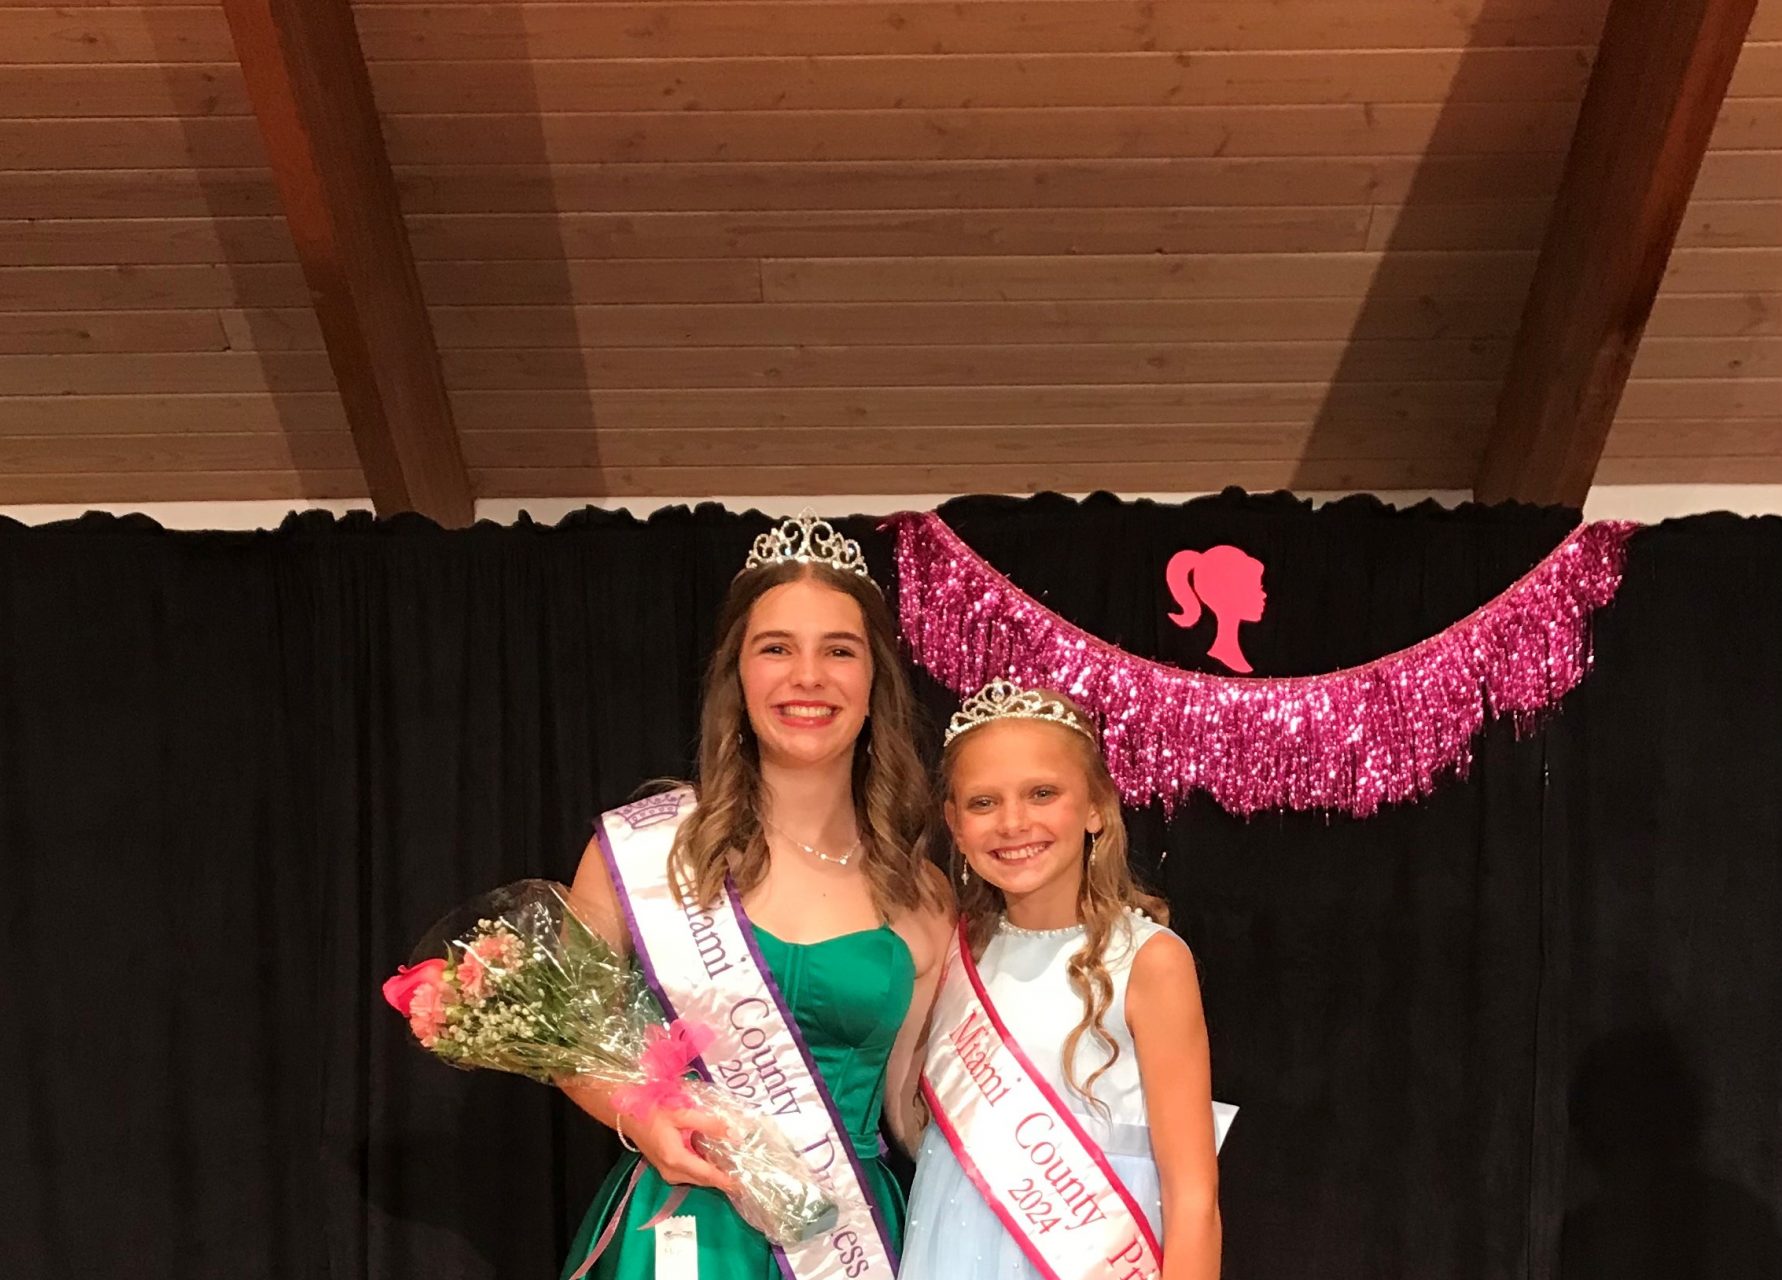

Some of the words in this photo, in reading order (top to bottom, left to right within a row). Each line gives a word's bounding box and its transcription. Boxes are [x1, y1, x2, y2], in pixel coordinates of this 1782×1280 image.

[718, 1059, 763, 1110] 202
[730, 998, 801, 1115] County
[795, 1132, 870, 1279] Dess
[950, 1009, 1021, 1107] Miami
[1015, 1112, 1107, 1230] County
[1008, 1178, 1061, 1234] 2024
